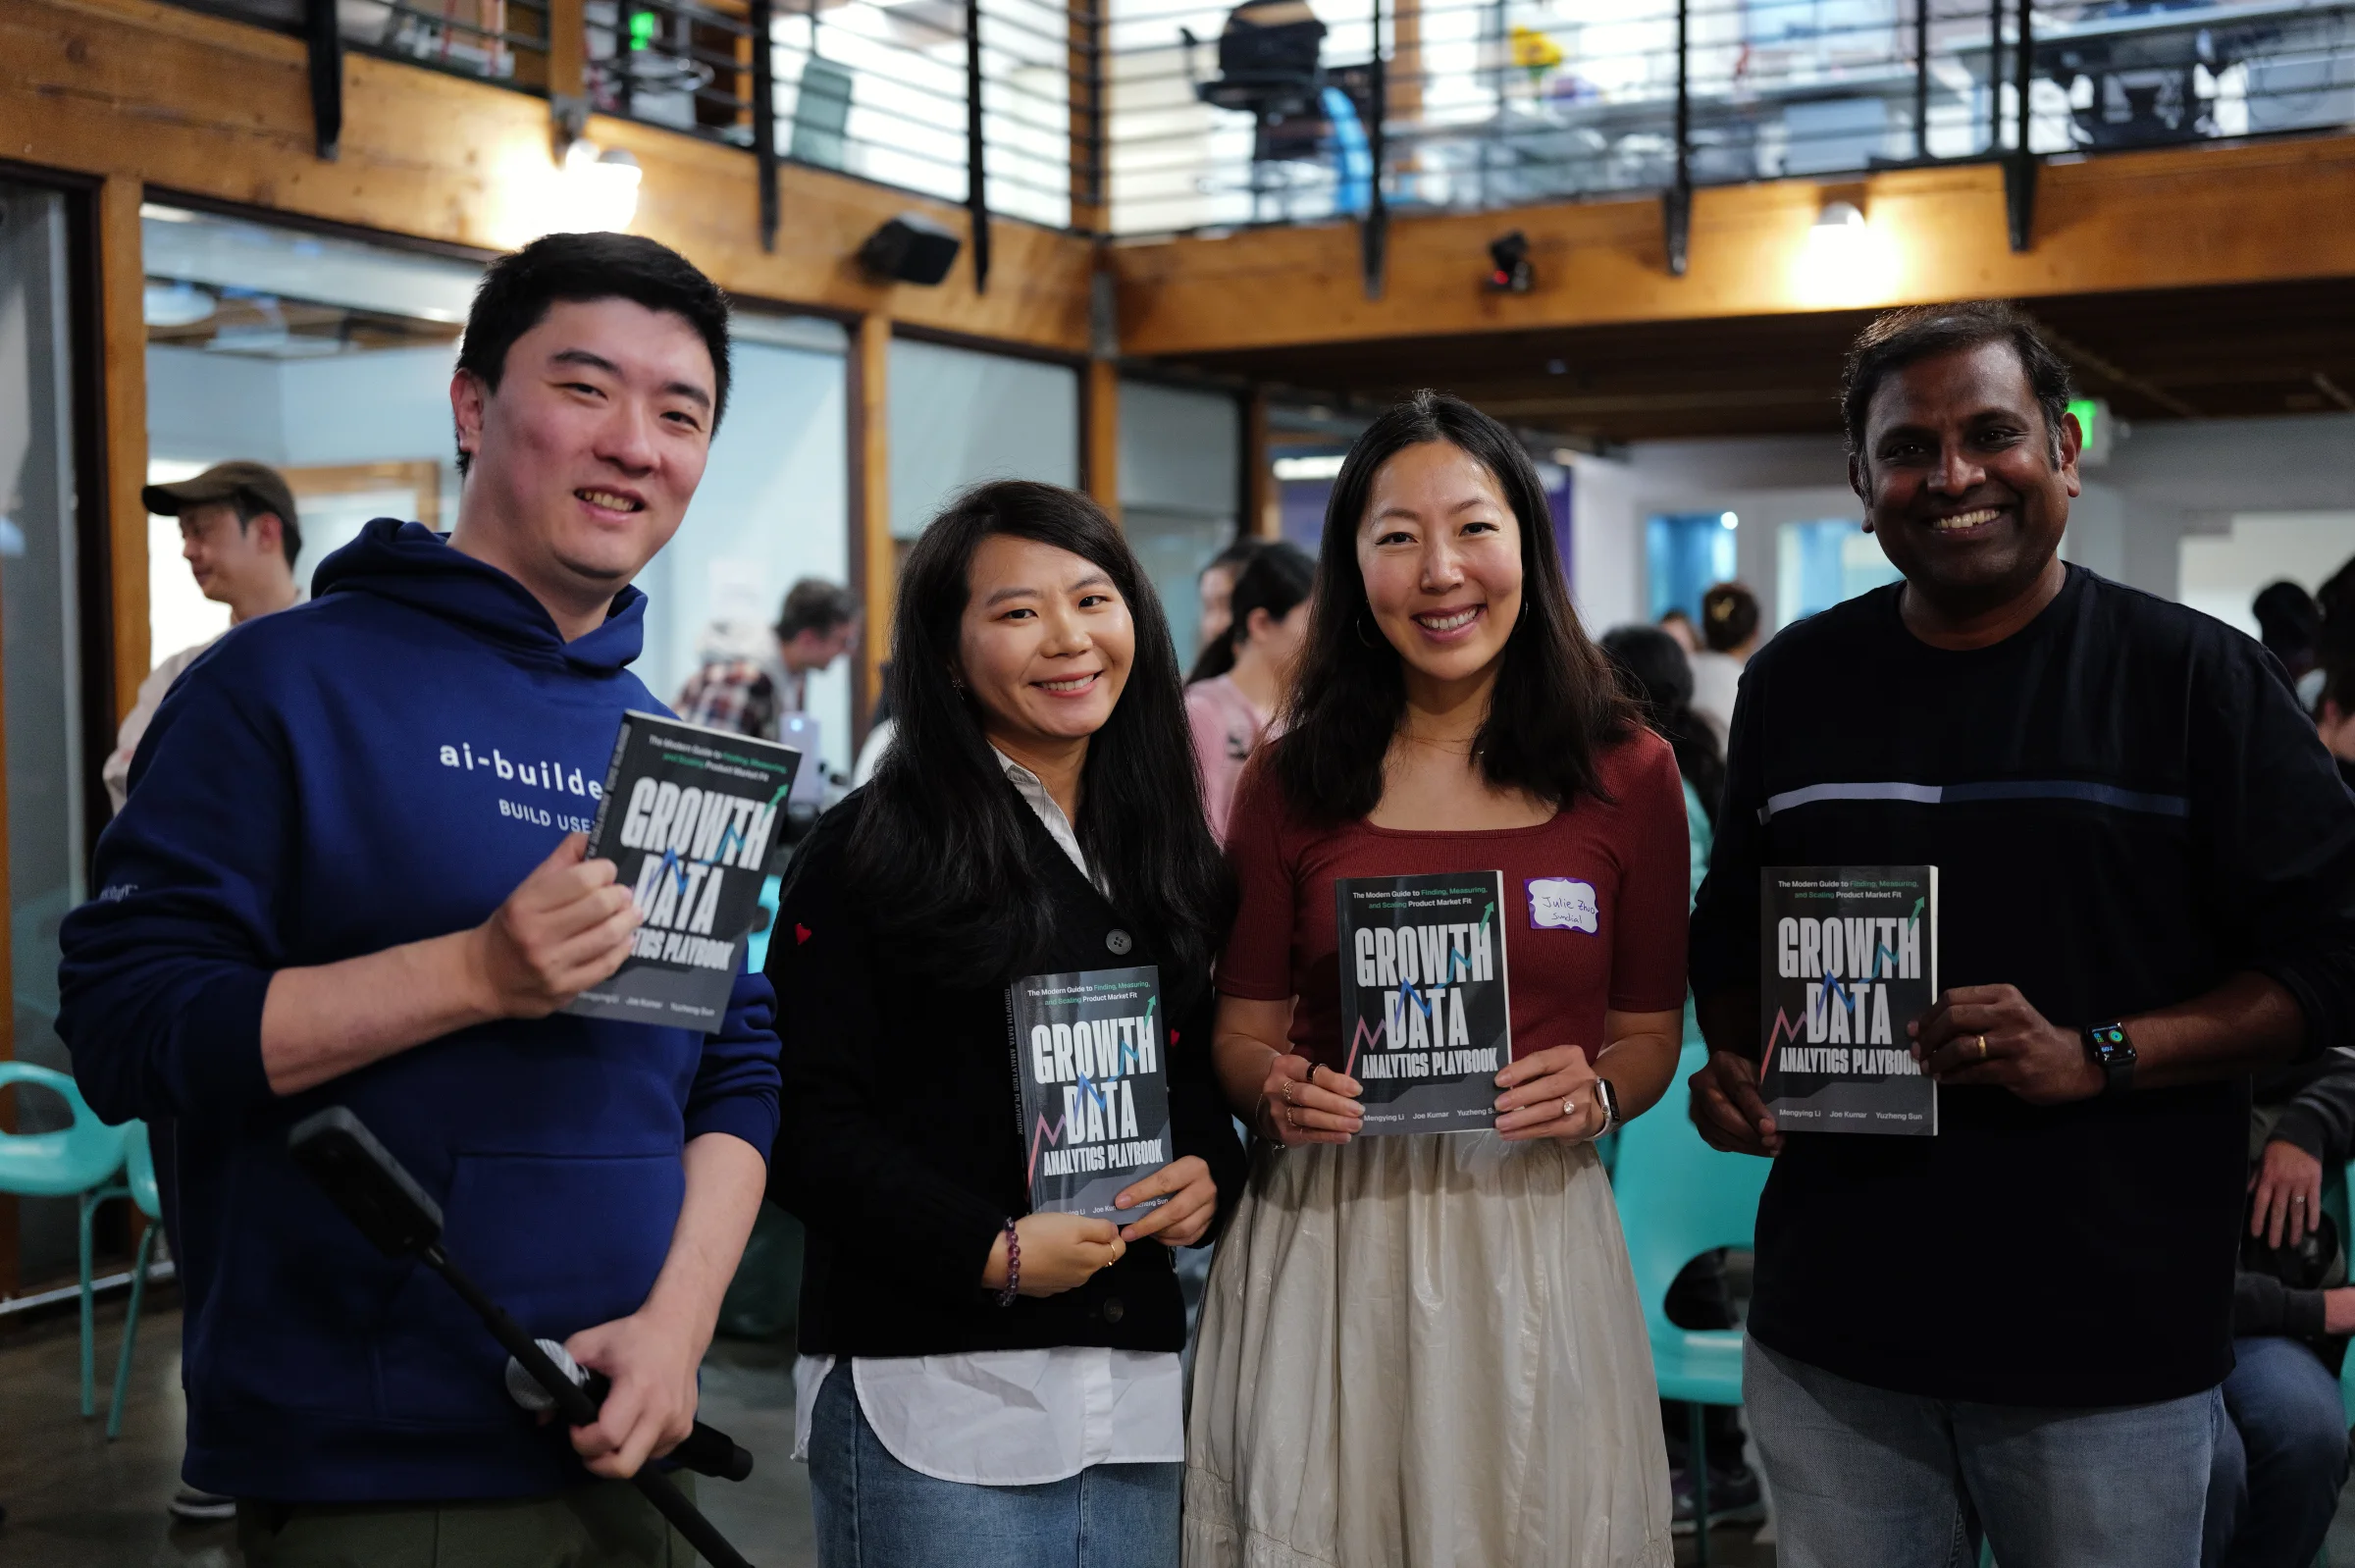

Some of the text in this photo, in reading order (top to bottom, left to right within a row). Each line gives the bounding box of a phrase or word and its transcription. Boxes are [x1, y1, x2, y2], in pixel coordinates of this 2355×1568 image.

[498, 798, 595, 834] BUILD USE
[620, 776, 777, 871] GROWTH
[632, 853, 725, 936] DATA
[1421, 888, 1448, 897] Finding,
[1449, 886, 1488, 895] Measuring,
[1542, 896, 1574, 910] Julie
[1808, 891, 1835, 900] Scaling
[661, 931, 736, 971] PLAYBOOK
[1354, 921, 1493, 987] GROWTH
[1778, 917, 1921, 979] GROWTH
[1041, 987, 1067, 996] Modern
[1093, 982, 1118, 991] Finding,
[1118, 980, 1151, 989] Measuring,
[1058, 997, 1082, 1006] Scaling
[1082, 994, 1107, 1003] Product
[1384, 986, 1469, 1050] DATA
[1806, 982, 1892, 1045] DATA
[1030, 1016, 1157, 1085] GROWTH
[1362, 1047, 1498, 1079] ANALYTICS PLAYBOOK
[1779, 1047, 1850, 1073] ANALYTICS
[1063, 1079, 1139, 1145] DATA
[1364, 1114, 1397, 1123] Mengying
[1779, 1109, 1813, 1118] Mengying
[1044, 1138, 1164, 1176] ANALYTICS PLAYBOOK
